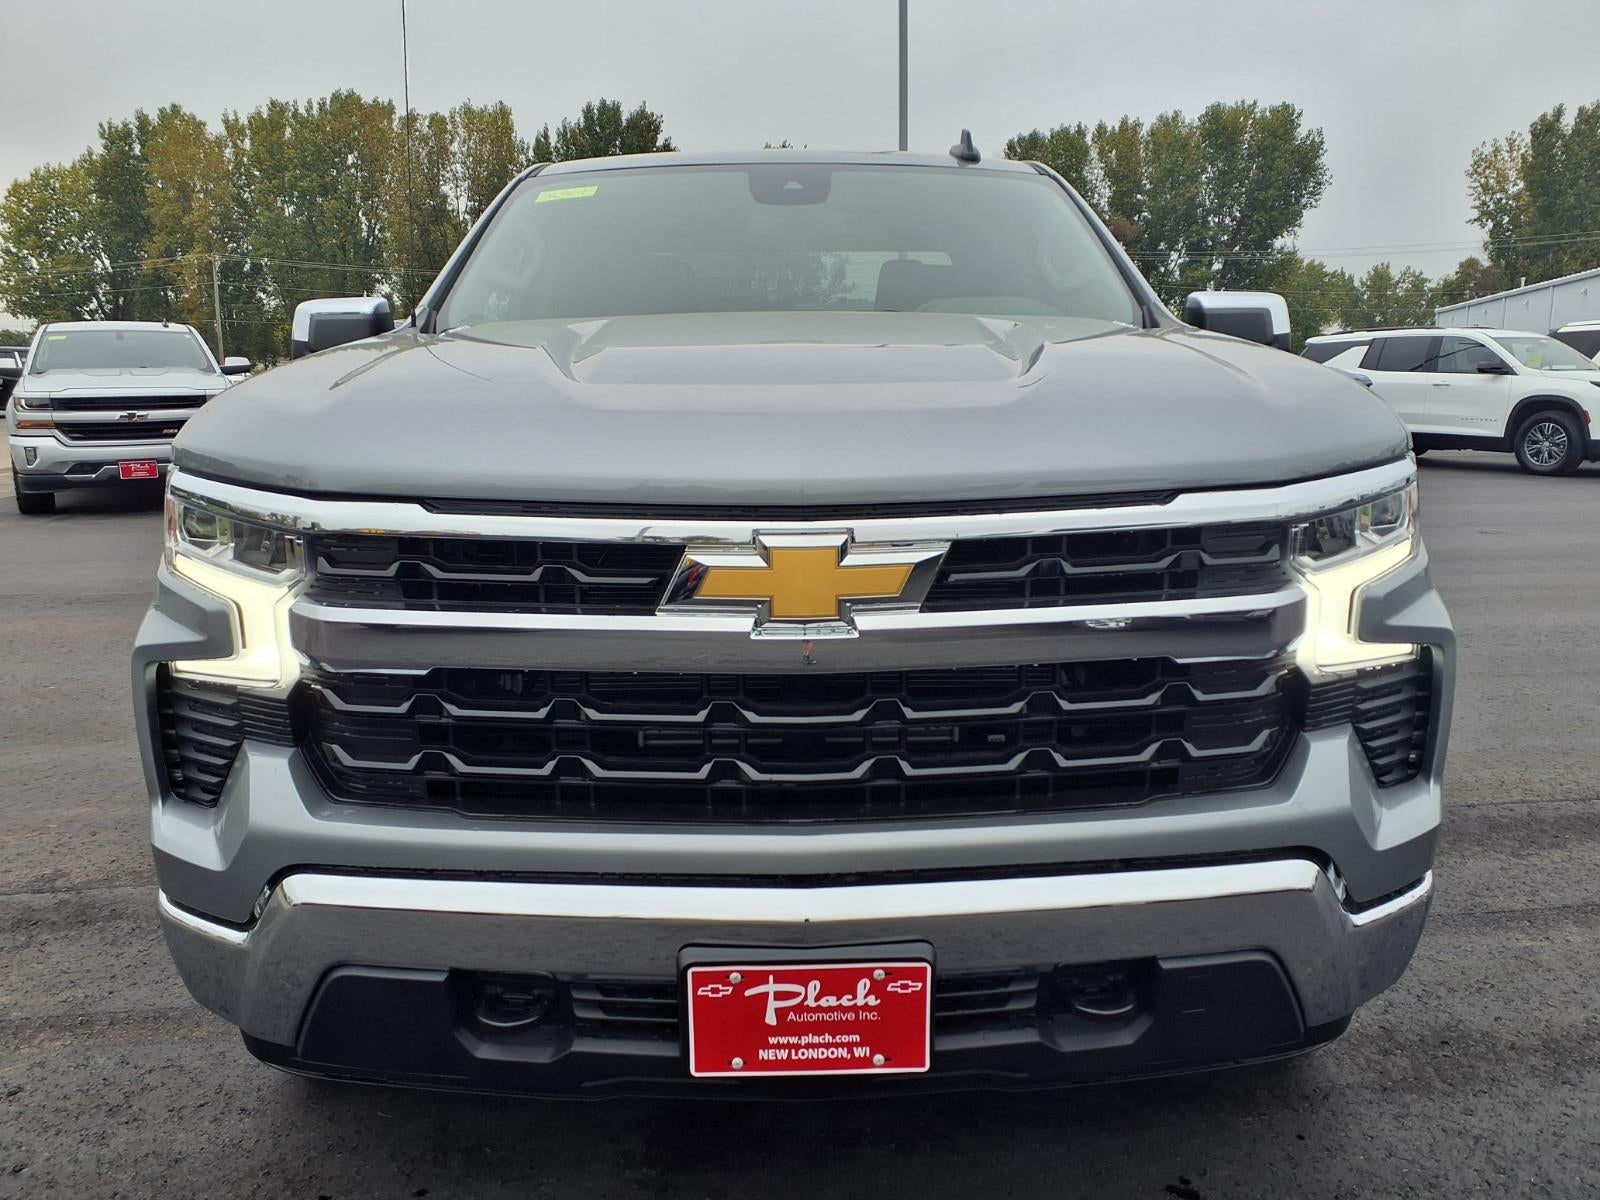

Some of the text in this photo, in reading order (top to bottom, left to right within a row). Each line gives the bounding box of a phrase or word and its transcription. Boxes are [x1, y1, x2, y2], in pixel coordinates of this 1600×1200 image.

[744, 973, 881, 1026] Plach
[787, 1009, 881, 1022] Automotive Inc.
[768, 1033, 860, 1046] www.plach.com
[758, 1046, 870, 1060] NEW LONDON, WI
